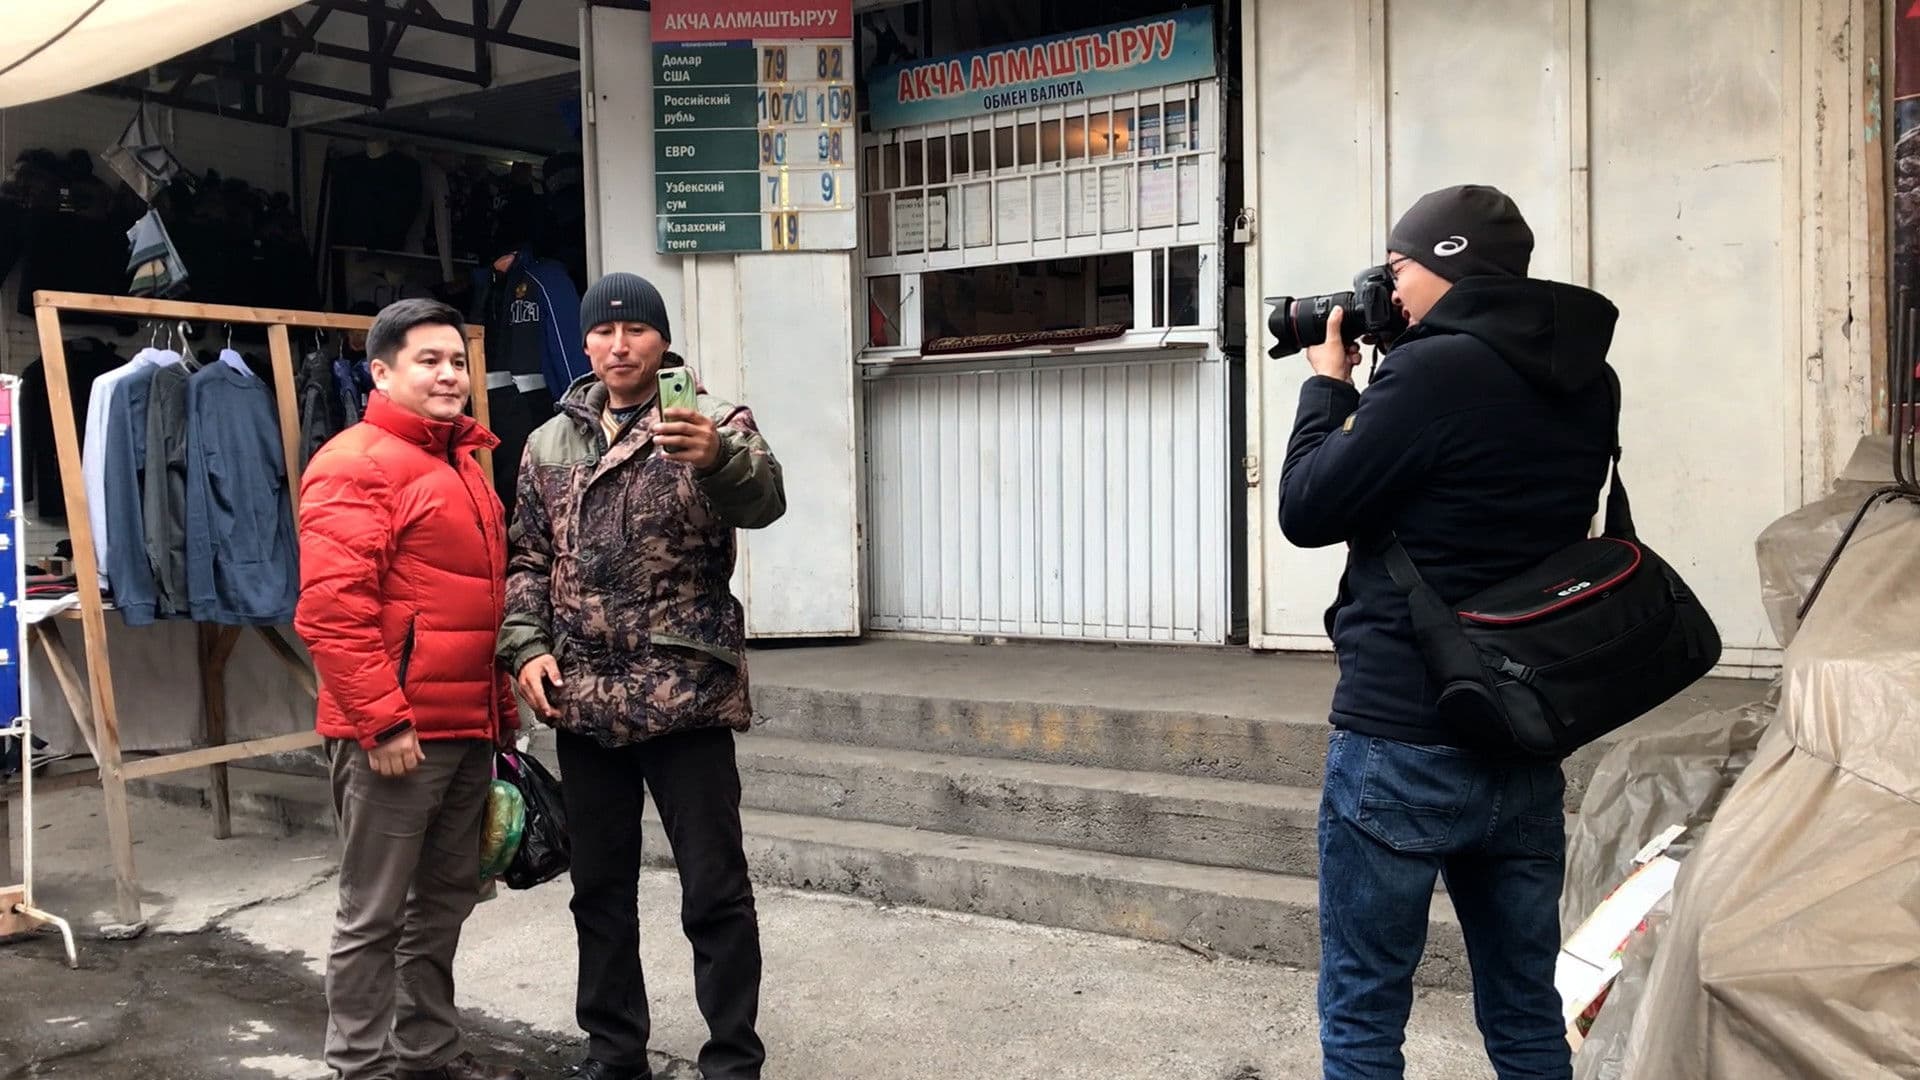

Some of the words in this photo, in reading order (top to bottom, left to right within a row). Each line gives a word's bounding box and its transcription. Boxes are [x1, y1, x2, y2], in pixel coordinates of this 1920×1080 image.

[664, 13, 711, 30] АКЧА
[713, 9, 839, 29] АЛМАШТЫРУУ
[662, 54, 702, 67] Доллар
[764, 48, 785, 79] 79
[819, 47, 841, 79] 82
[899, 67, 965, 102] АКЧА
[970, 20, 1176, 90] АЛМАШТЫРУУ
[663, 70, 690, 82] США
[664, 94, 731, 106] Российский
[983, 89, 1028, 111] ОБМЕН
[1031, 80, 1085, 103] ВАЛЮТА
[664, 111, 696, 125] рубль
[665, 145, 696, 157] ЕВРО
[762, 132, 786, 164] 90
[818, 132, 842, 161] 98
[665, 180, 725, 193] Узбекский
[767, 176, 780, 204] 7
[821, 172, 834, 202] 9
[666, 199, 687, 209] сум
[667, 221, 726, 233] Казахский
[774, 214, 799, 246] 19
[667, 239, 697, 249] тенге
